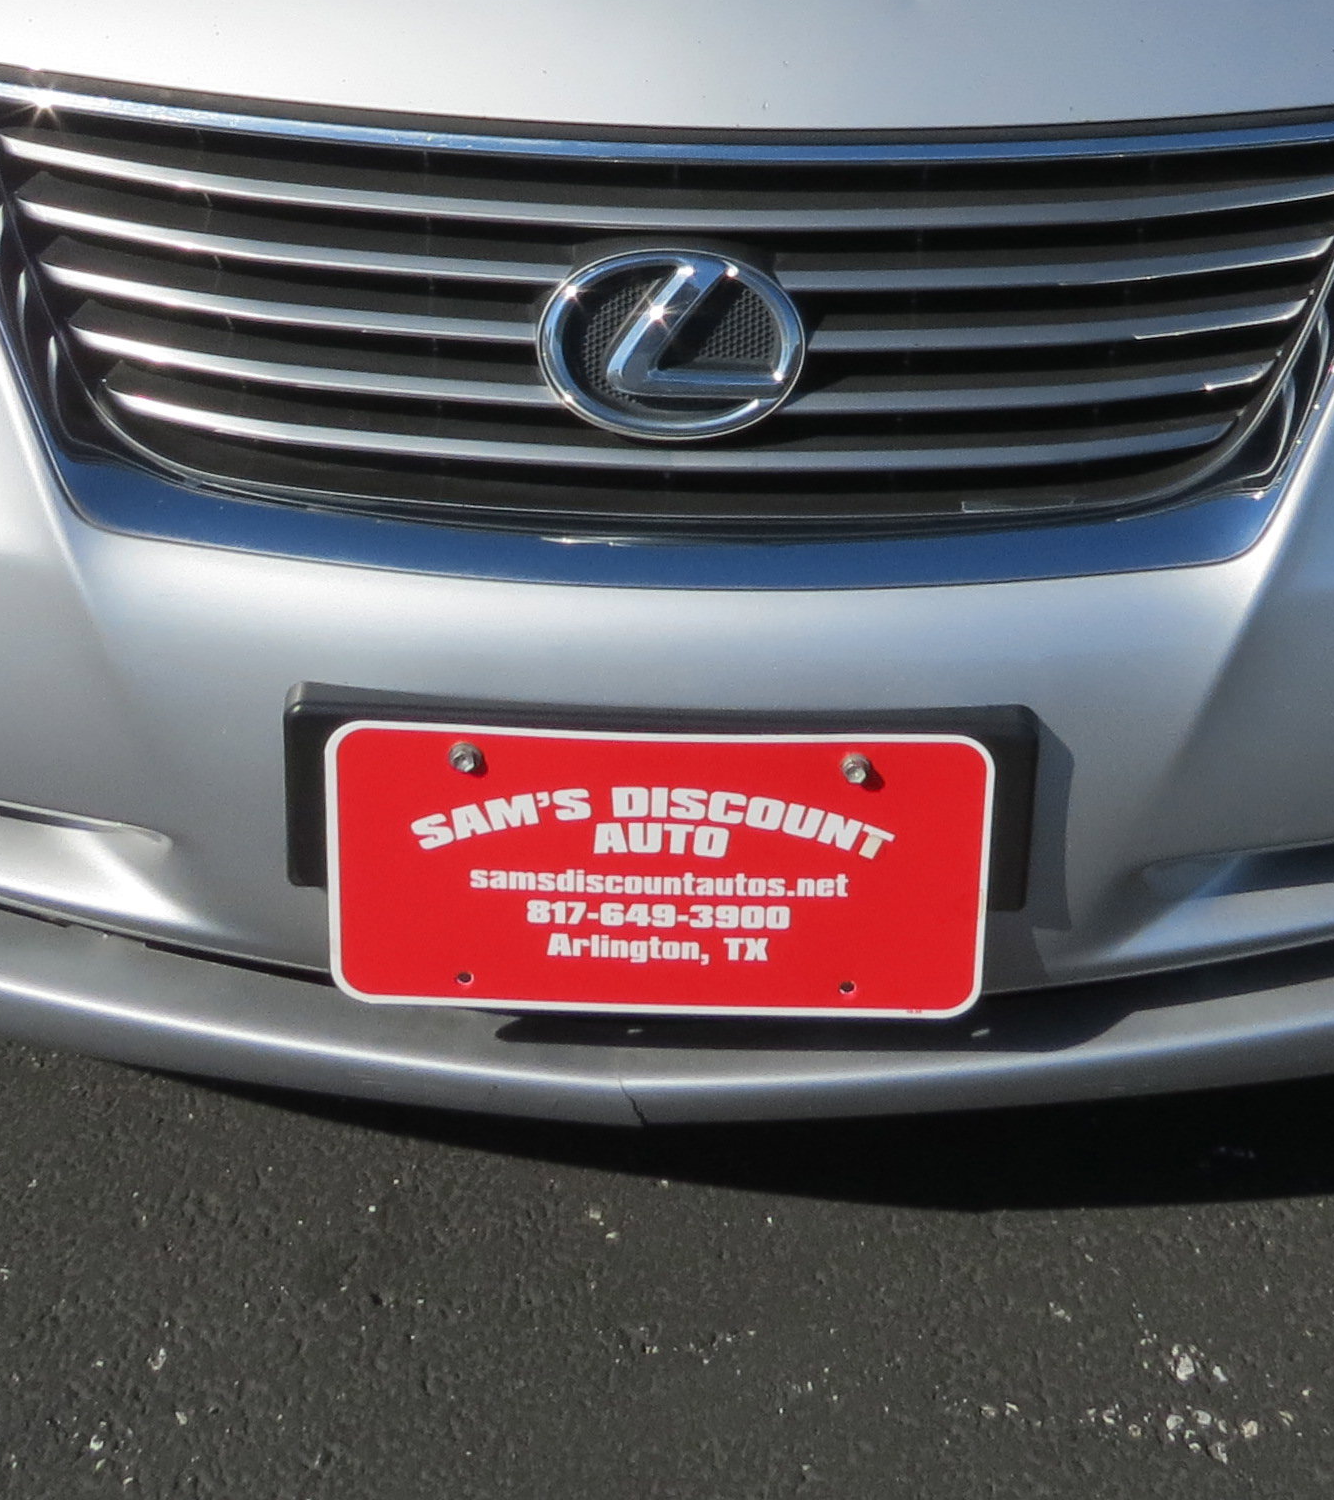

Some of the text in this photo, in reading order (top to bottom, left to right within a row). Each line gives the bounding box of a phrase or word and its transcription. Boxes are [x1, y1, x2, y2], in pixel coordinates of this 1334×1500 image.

[410, 786, 896, 860] SAM'S DISCOUNT
[593, 822, 730, 859] AUTO
[469, 867, 849, 898] samsdiscountautos.net
[526, 899, 791, 930] 817-649-3900
[547, 932, 769, 965] Arlington, TX
